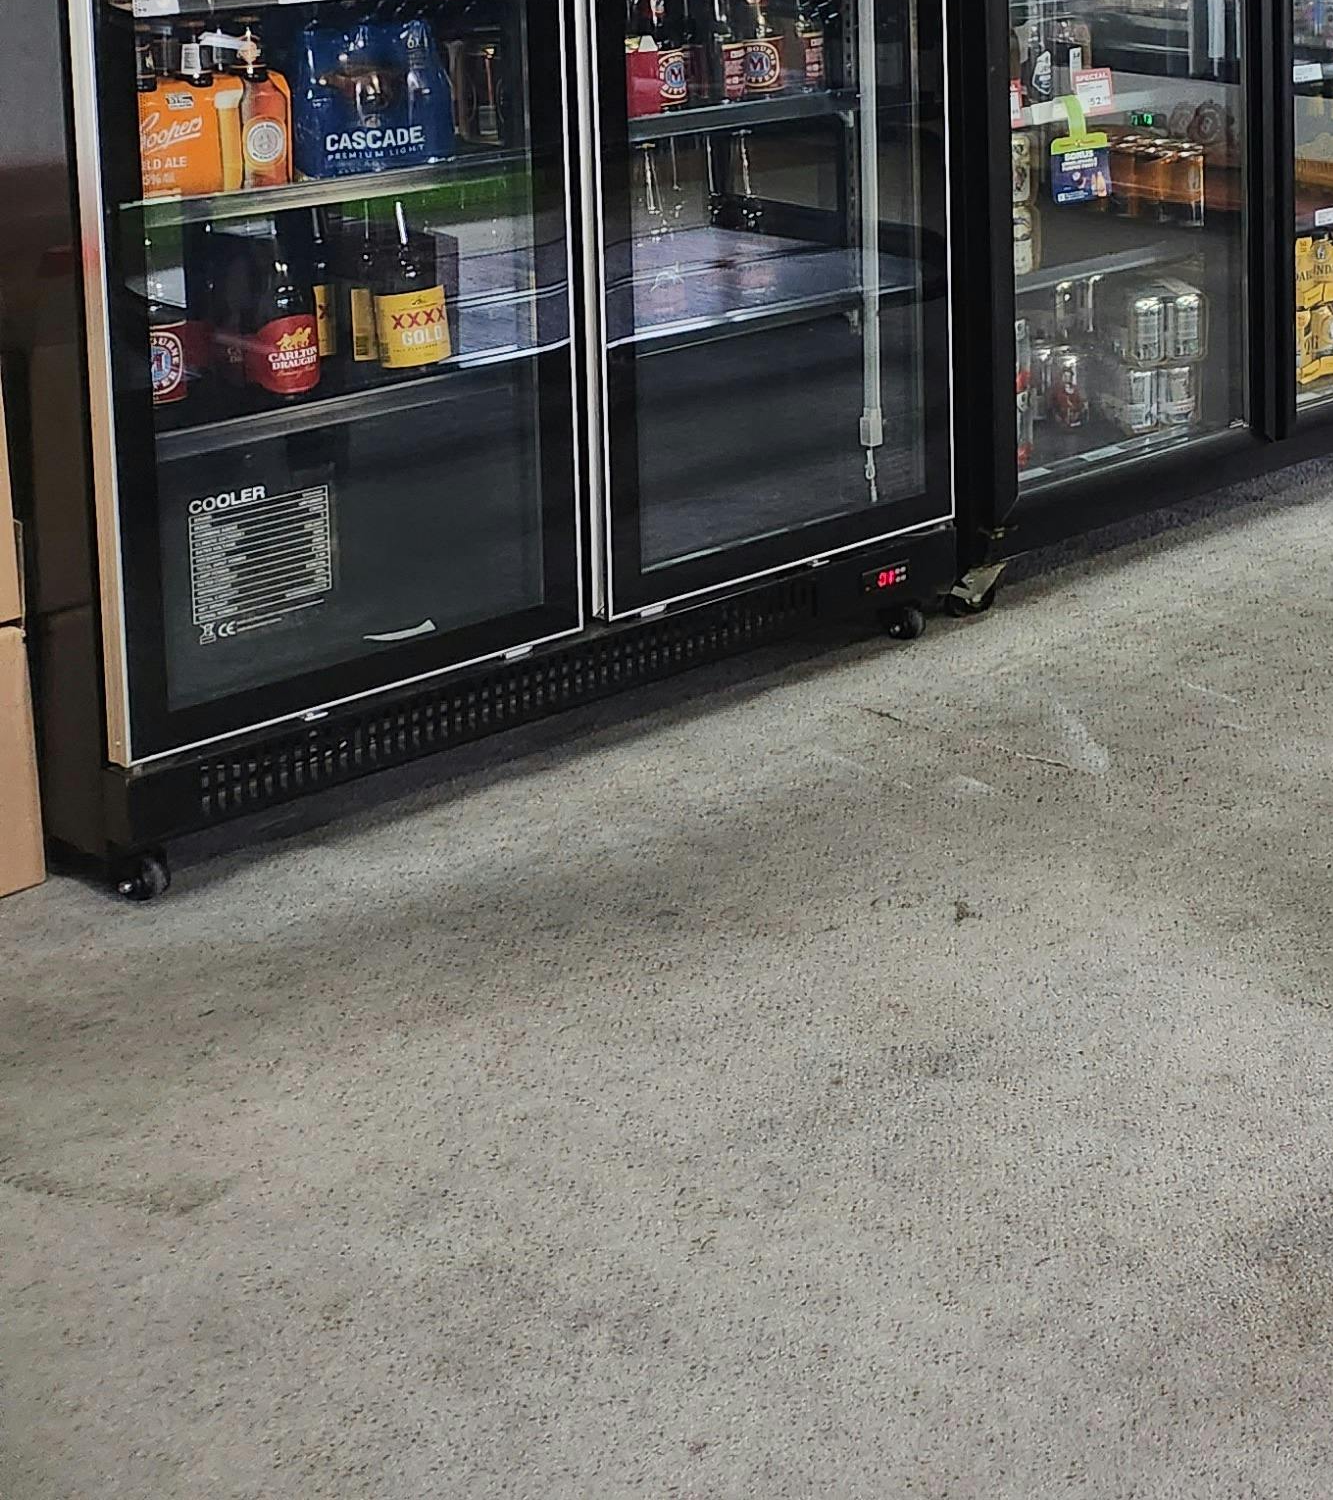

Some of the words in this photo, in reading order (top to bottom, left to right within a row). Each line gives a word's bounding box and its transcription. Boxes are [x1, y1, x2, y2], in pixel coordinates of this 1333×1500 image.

[325, 126, 424, 152] CASCADE
[165, 156, 188, 169] ALE
[327, 149, 386, 161] PREMIUM
[390, 144, 426, 157] LIGHT
[391, 305, 445, 330] XXXX
[402, 324, 442, 346] GOLD
[268, 346, 318, 364] CARLTON
[271, 355, 319, 371] DRAUGHT
[188, 485, 266, 514] COOLER
